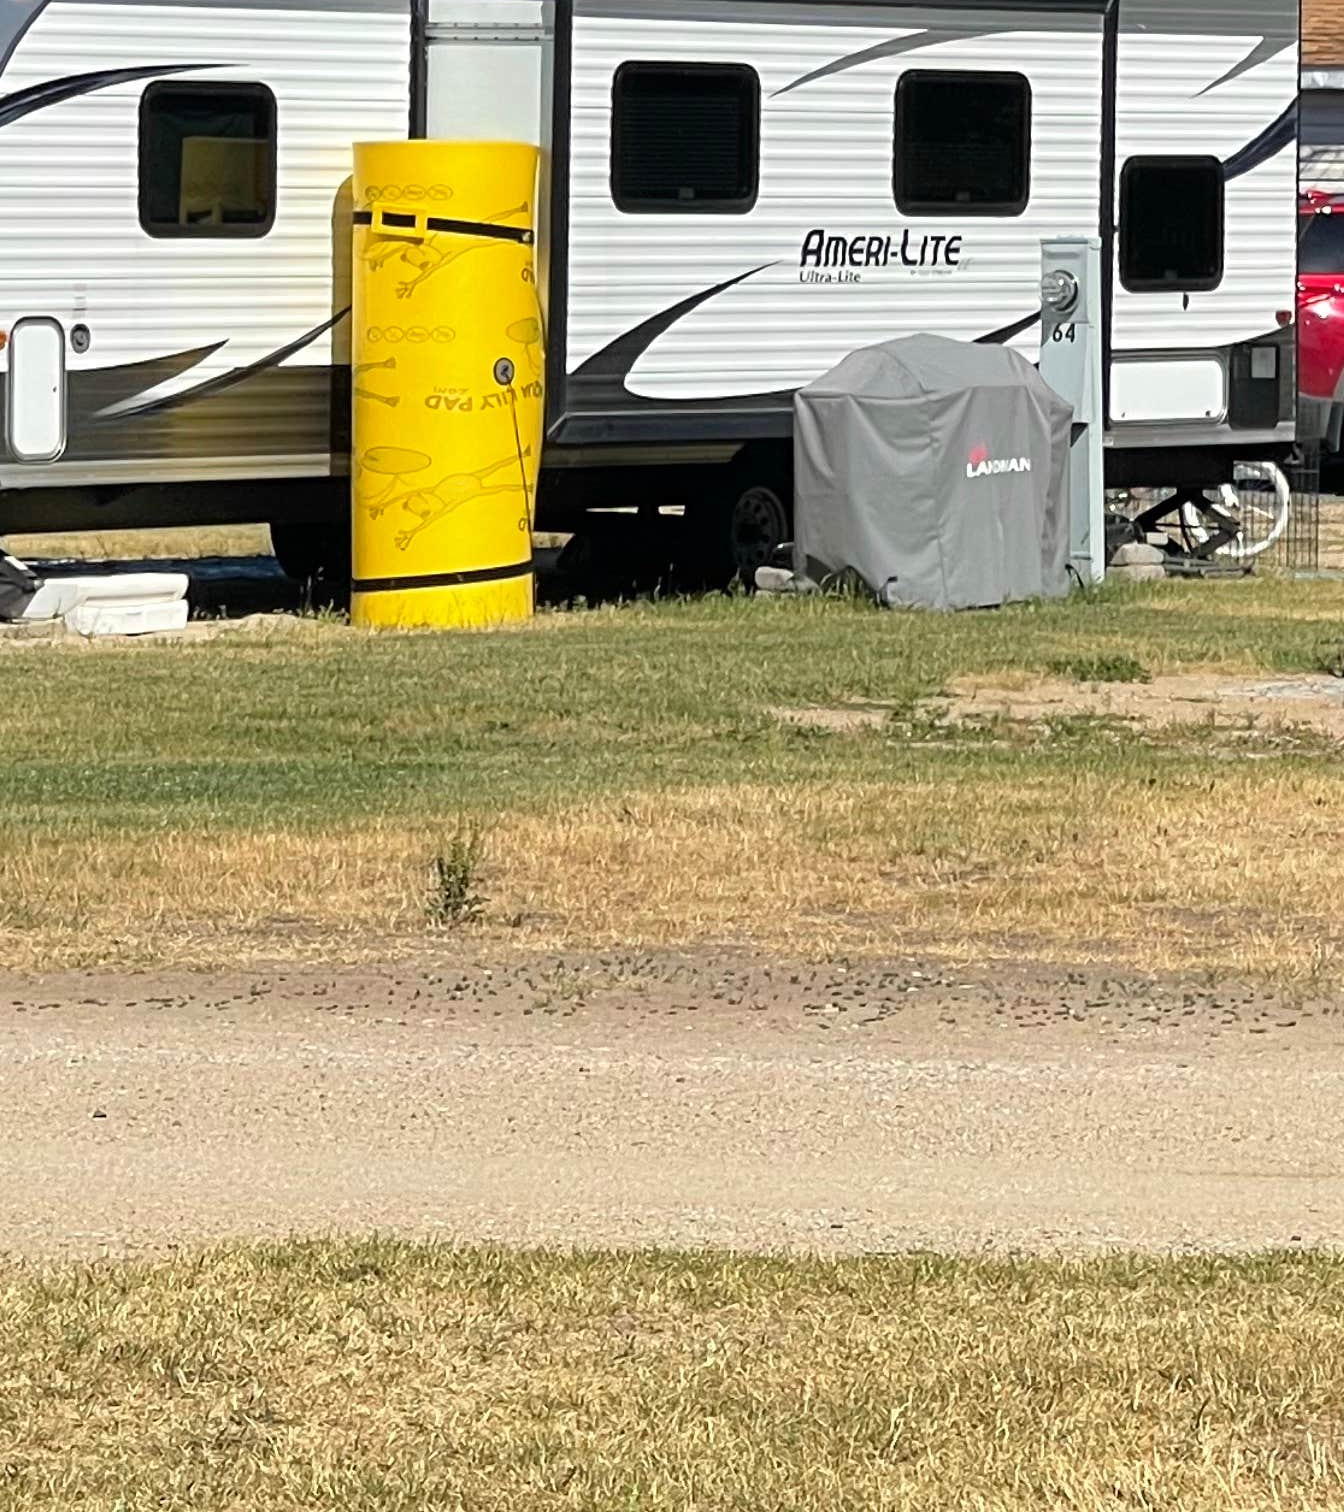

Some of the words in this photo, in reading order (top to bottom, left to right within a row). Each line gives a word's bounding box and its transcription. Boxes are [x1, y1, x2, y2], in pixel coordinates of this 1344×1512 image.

[800, 228, 963, 267] AMERI-LITE
[799, 270, 862, 284] Ultra-Lite
[1052, 322, 1075, 343] 64
[520, 380, 543, 399] QUA
[424, 394, 473, 412] PAD
